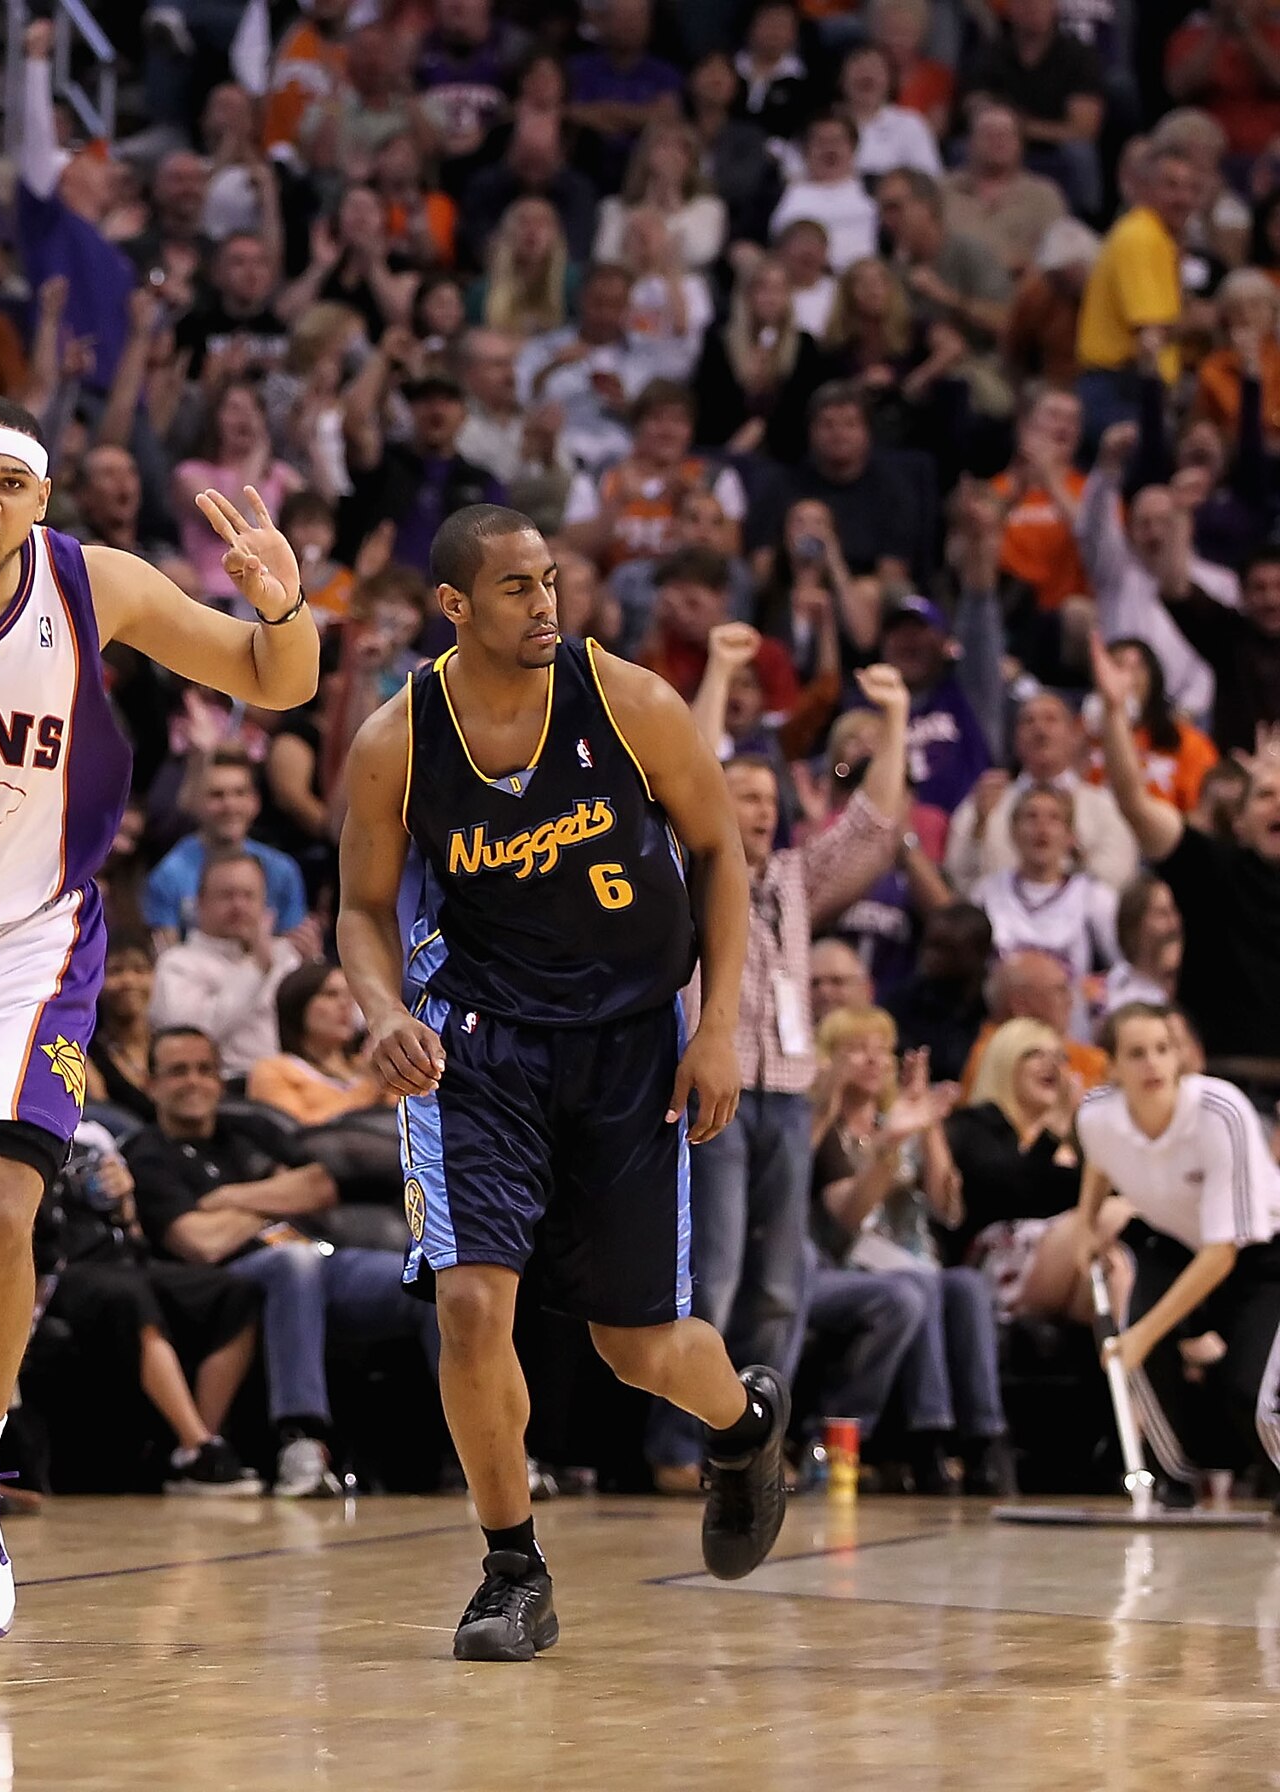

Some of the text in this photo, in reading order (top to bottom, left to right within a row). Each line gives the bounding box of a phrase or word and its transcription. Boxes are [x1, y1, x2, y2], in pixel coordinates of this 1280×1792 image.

[509, 775, 522, 794] D
[446, 798, 616, 882] Nuggets
[587, 861, 635, 912] 6
